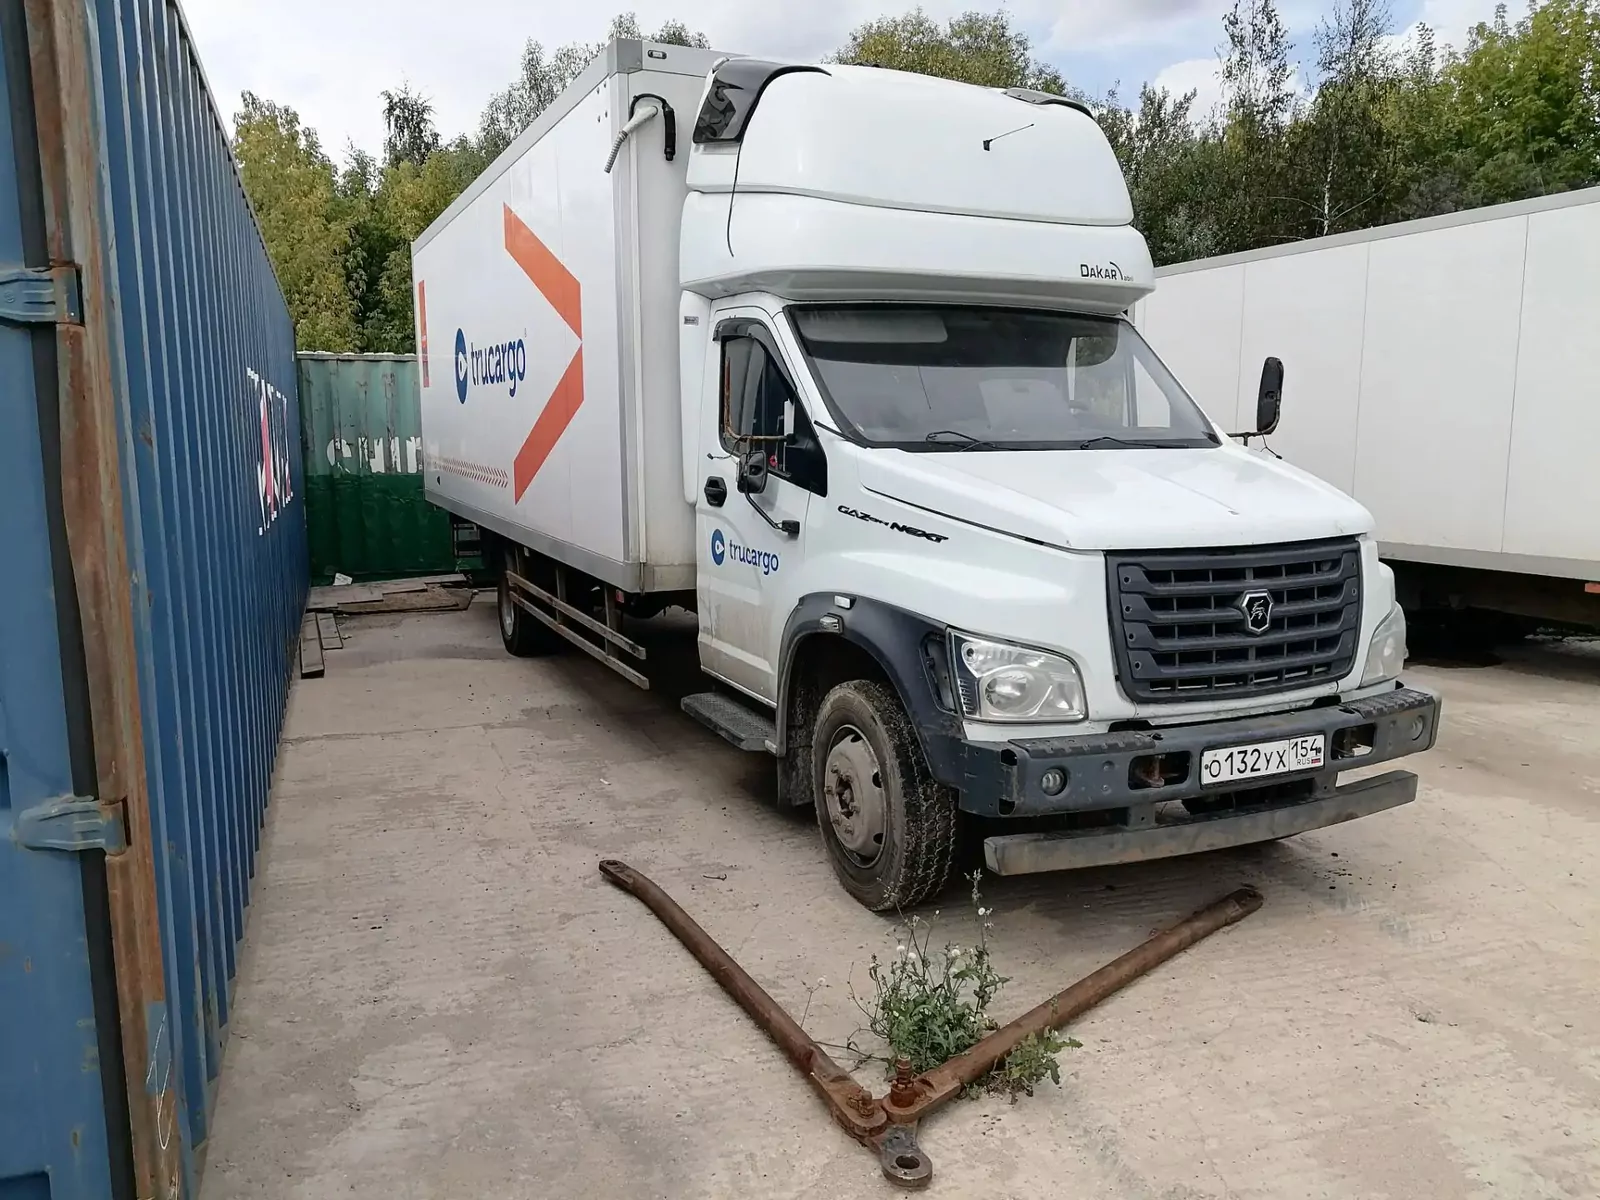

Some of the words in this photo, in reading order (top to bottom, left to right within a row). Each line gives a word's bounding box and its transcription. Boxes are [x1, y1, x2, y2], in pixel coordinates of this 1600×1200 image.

[1080, 263, 1117, 281] DAKAR
[470, 338, 526, 398] trucargo
[889, 521, 949, 543] NEXT
[729, 539, 779, 576] trucargo
[1290, 738, 1319, 759] 154
[1296, 758, 1312, 766] RUS
